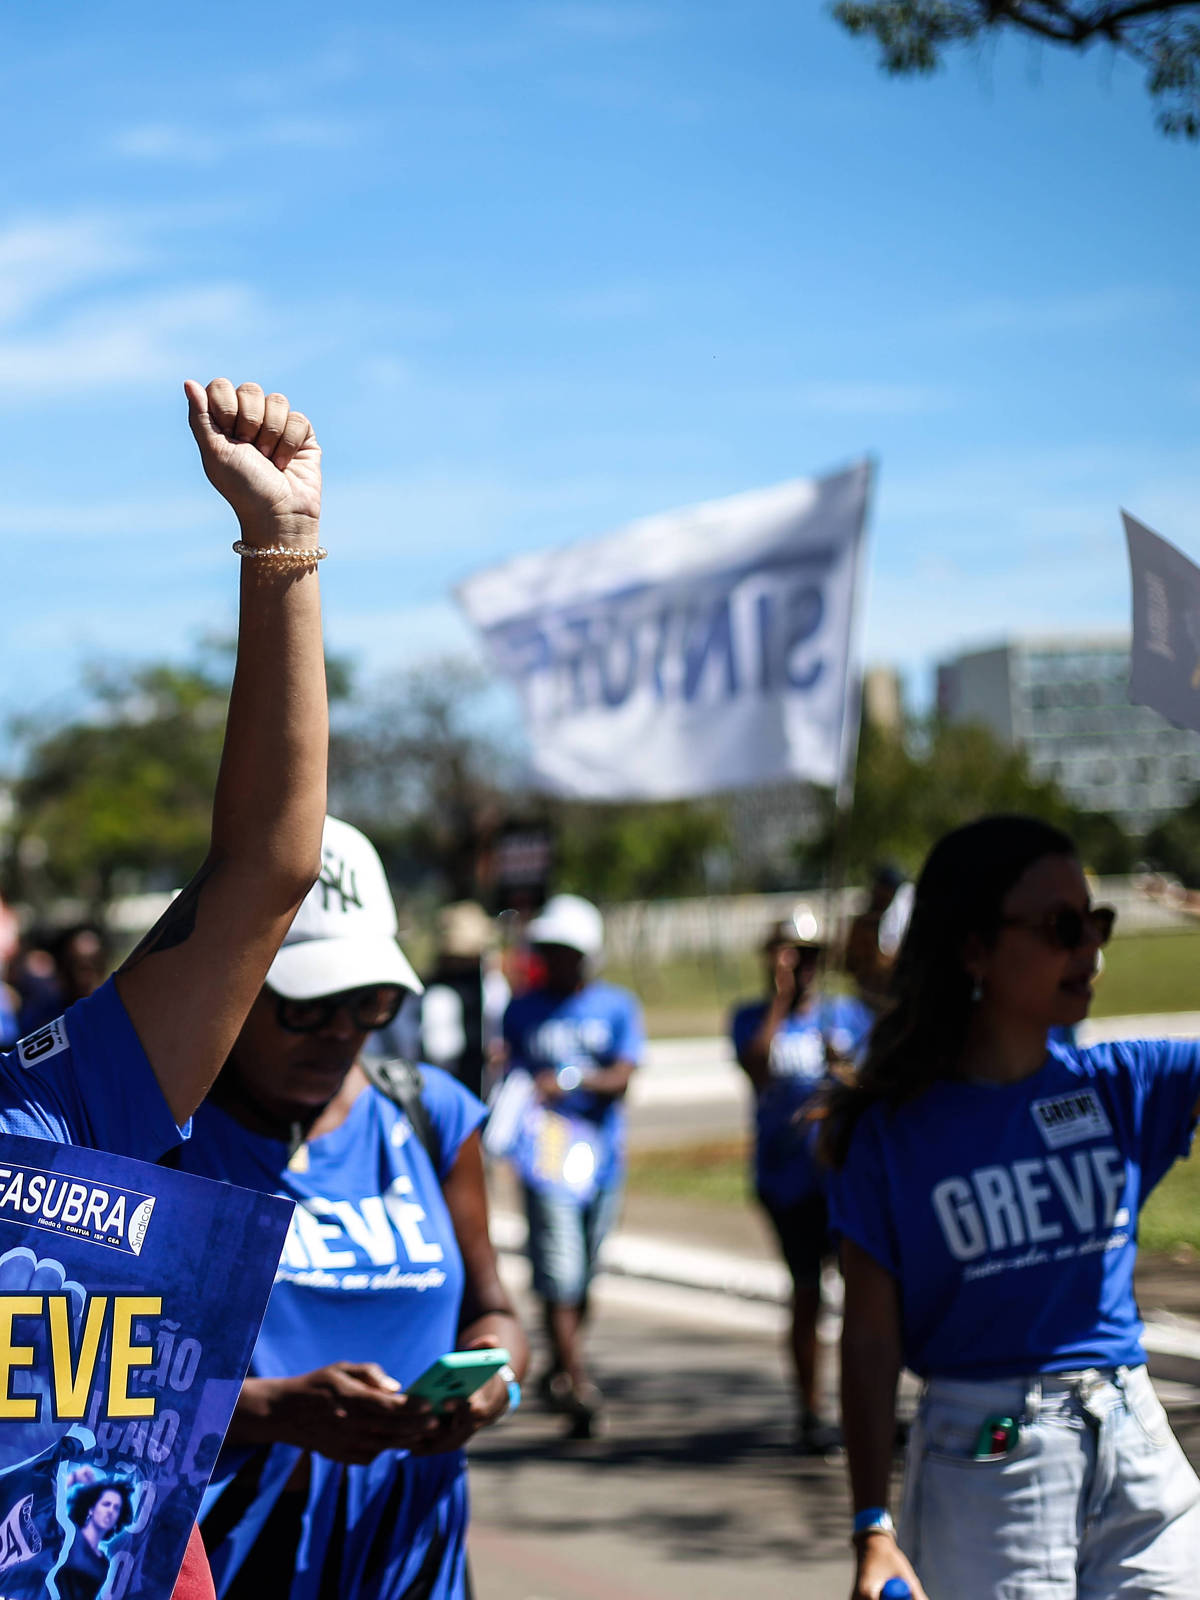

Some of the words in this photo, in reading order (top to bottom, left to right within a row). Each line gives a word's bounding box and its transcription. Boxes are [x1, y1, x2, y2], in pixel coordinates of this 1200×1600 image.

[131, 1202, 153, 1248] Sindical
[931, 1147, 1131, 1261] GREVE
[66, 1225, 90, 1237] CONTUA
